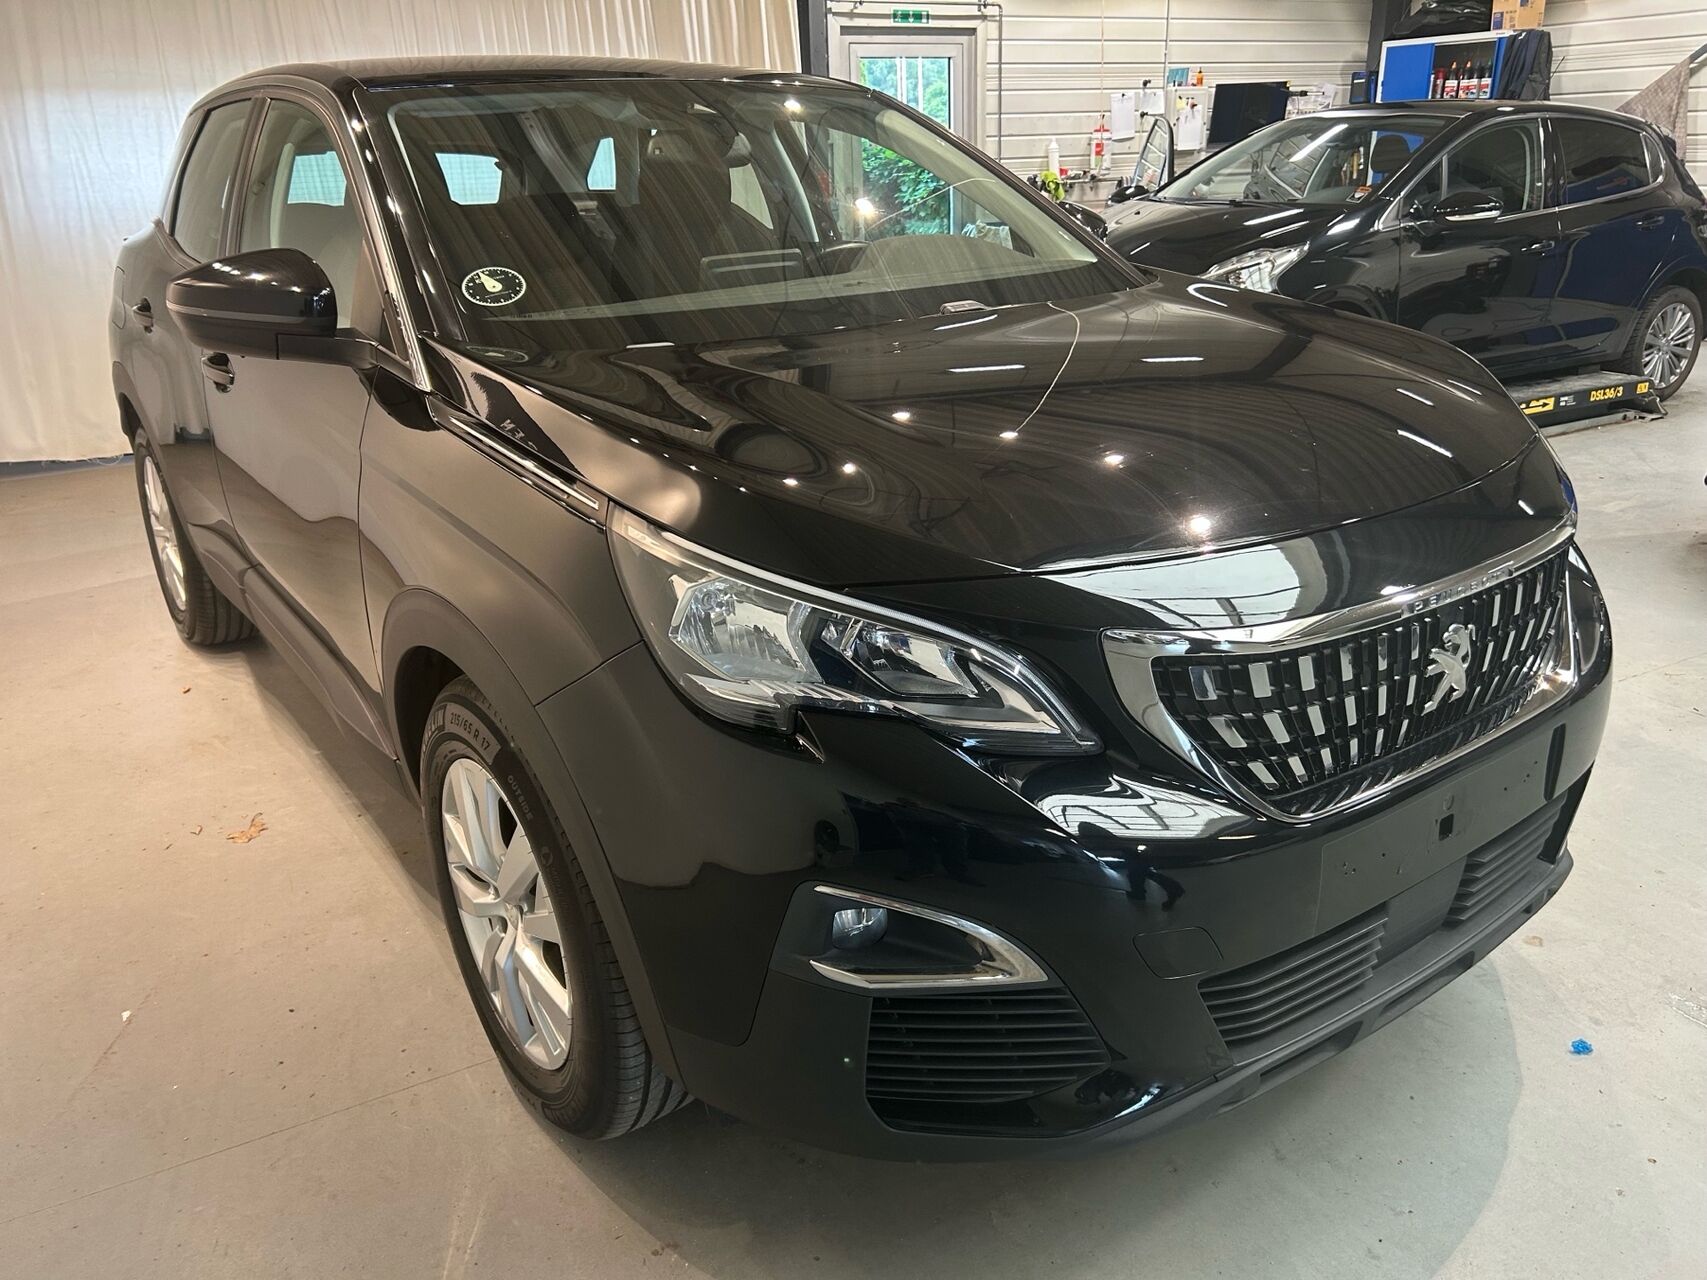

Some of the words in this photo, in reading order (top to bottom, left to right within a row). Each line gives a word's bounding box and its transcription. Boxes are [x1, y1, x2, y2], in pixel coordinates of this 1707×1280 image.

[1590, 387, 1623, 402] DSL36/3
[450, 712, 473, 734] 215/65
[473, 728, 480, 741] R
[481, 737, 491, 751] 17
[507, 775, 534, 819] OUTSIDE
